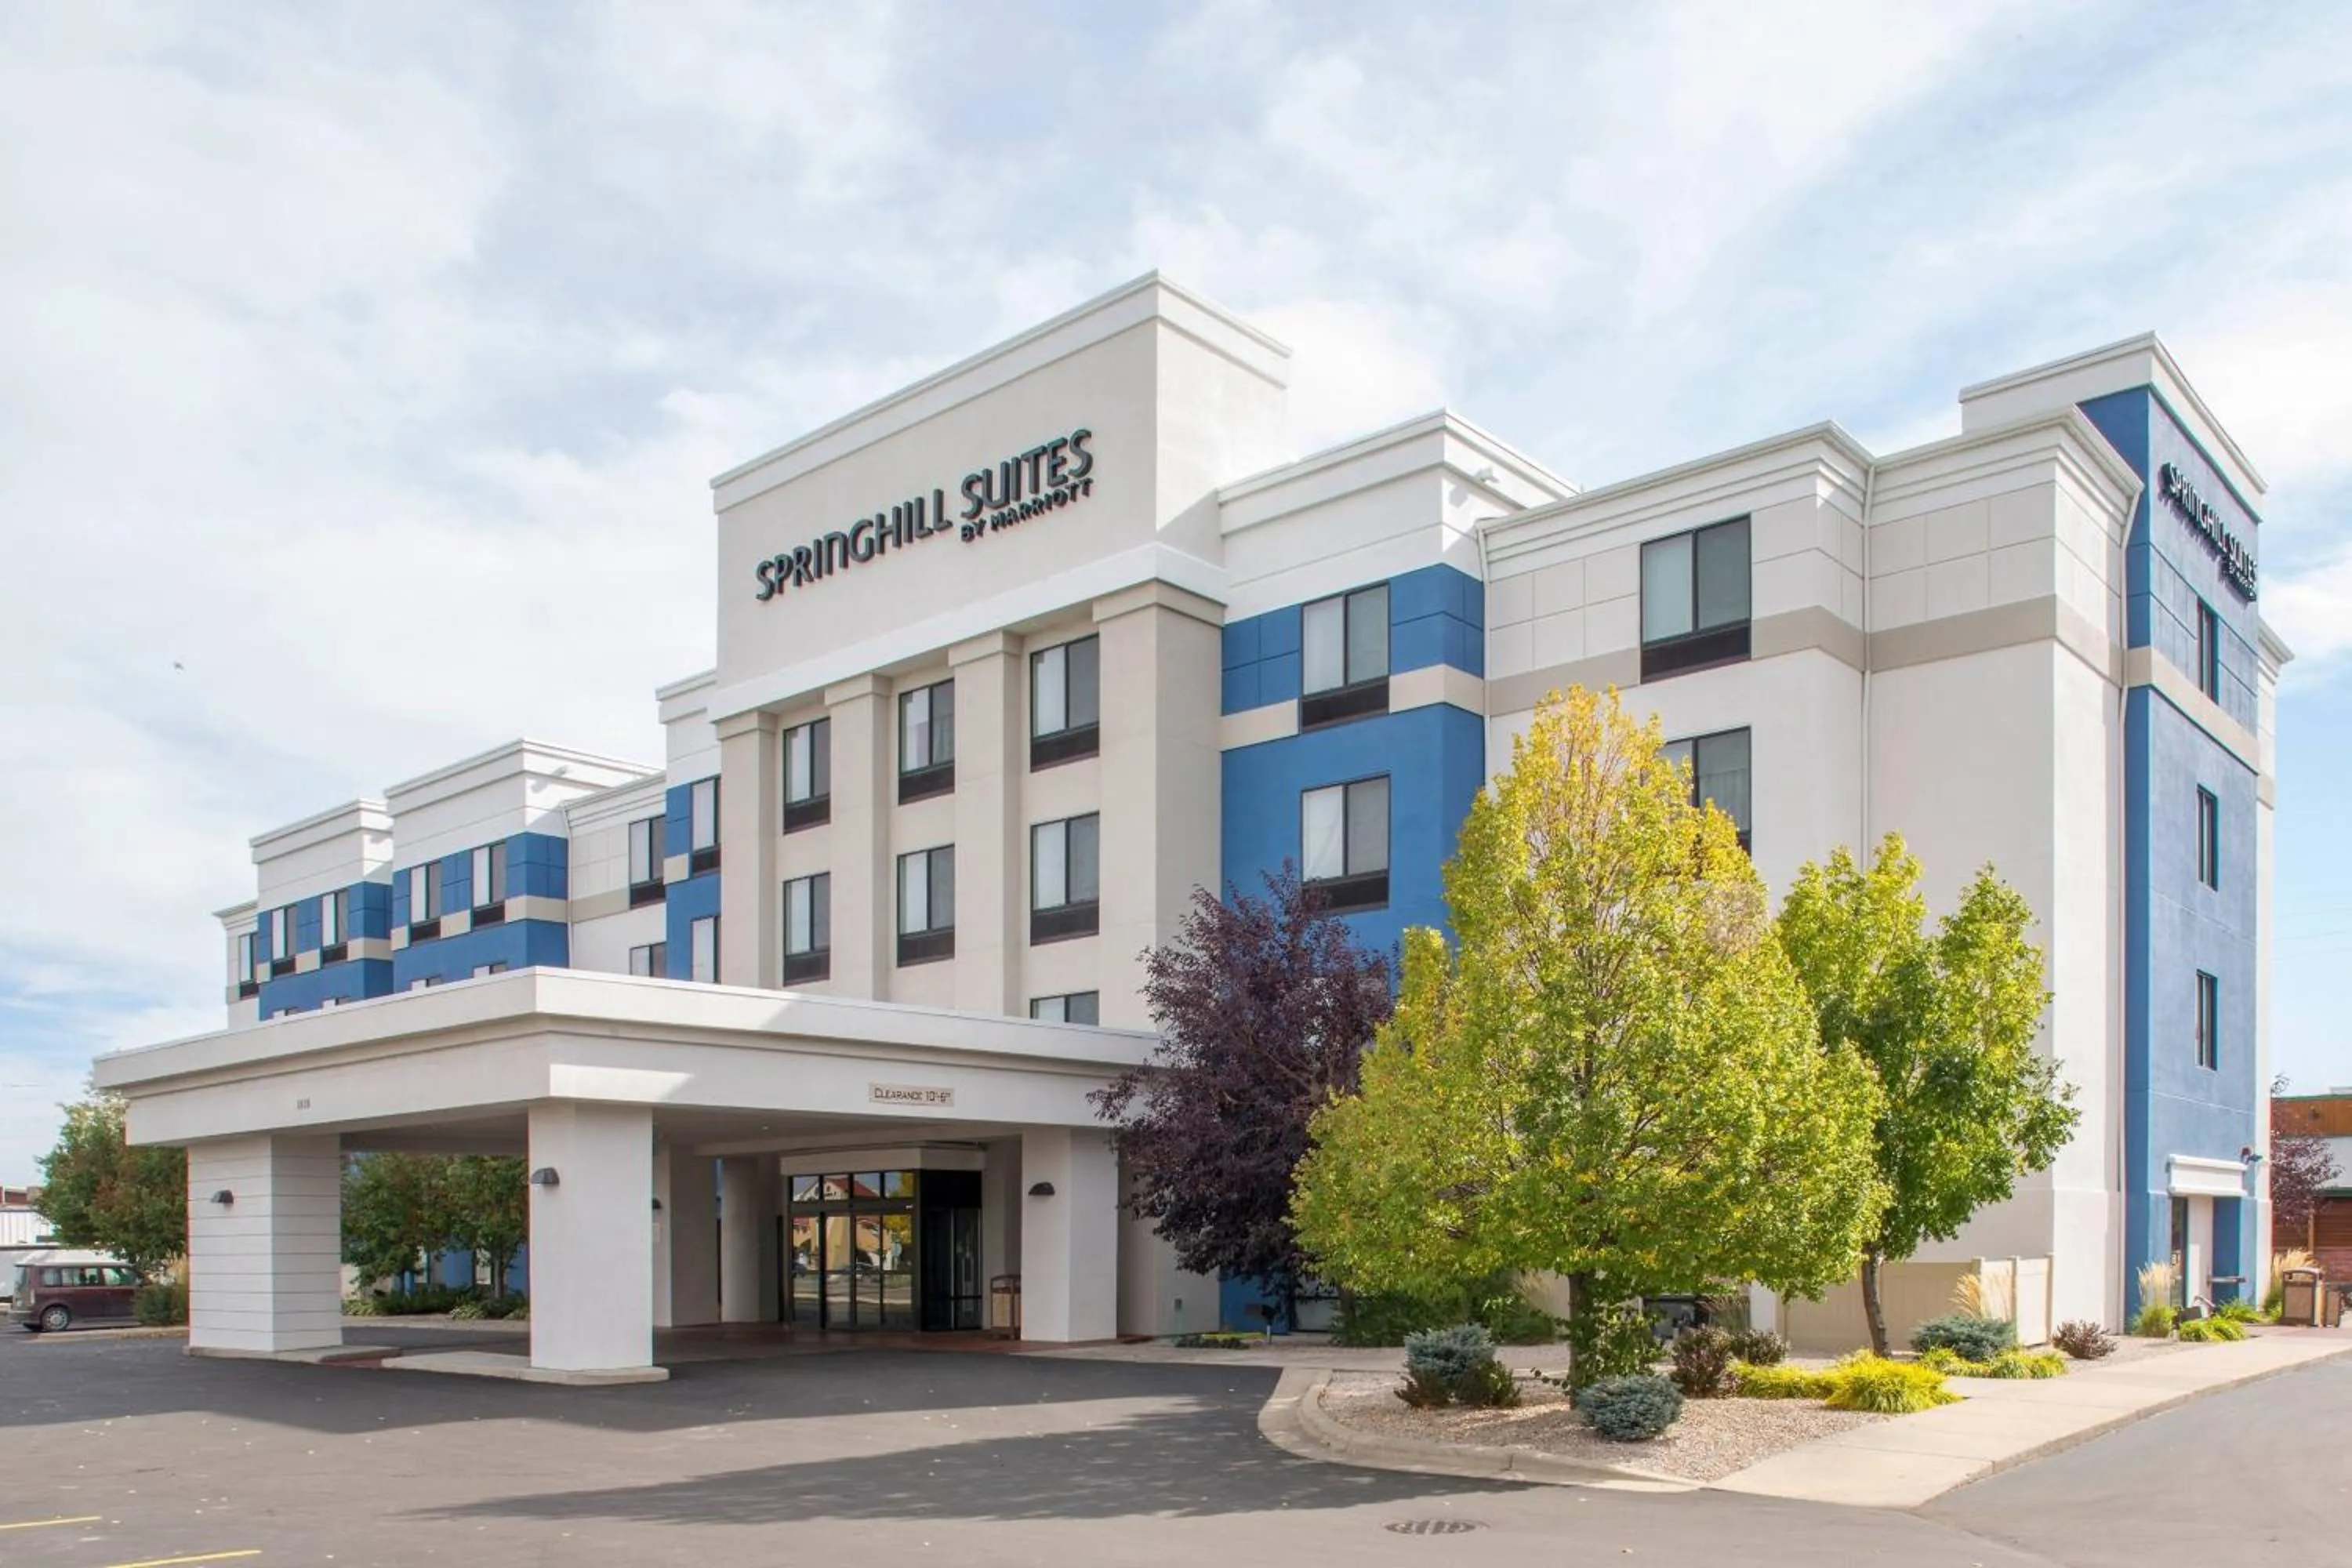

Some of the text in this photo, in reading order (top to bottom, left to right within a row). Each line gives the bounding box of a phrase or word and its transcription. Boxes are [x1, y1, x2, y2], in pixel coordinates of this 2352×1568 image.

[756, 428, 1092, 601] SPRINGHILL SUITES
[961, 477, 1094, 543] BY MARRIOTT
[874, 1087, 923, 1101] CLEARANCE
